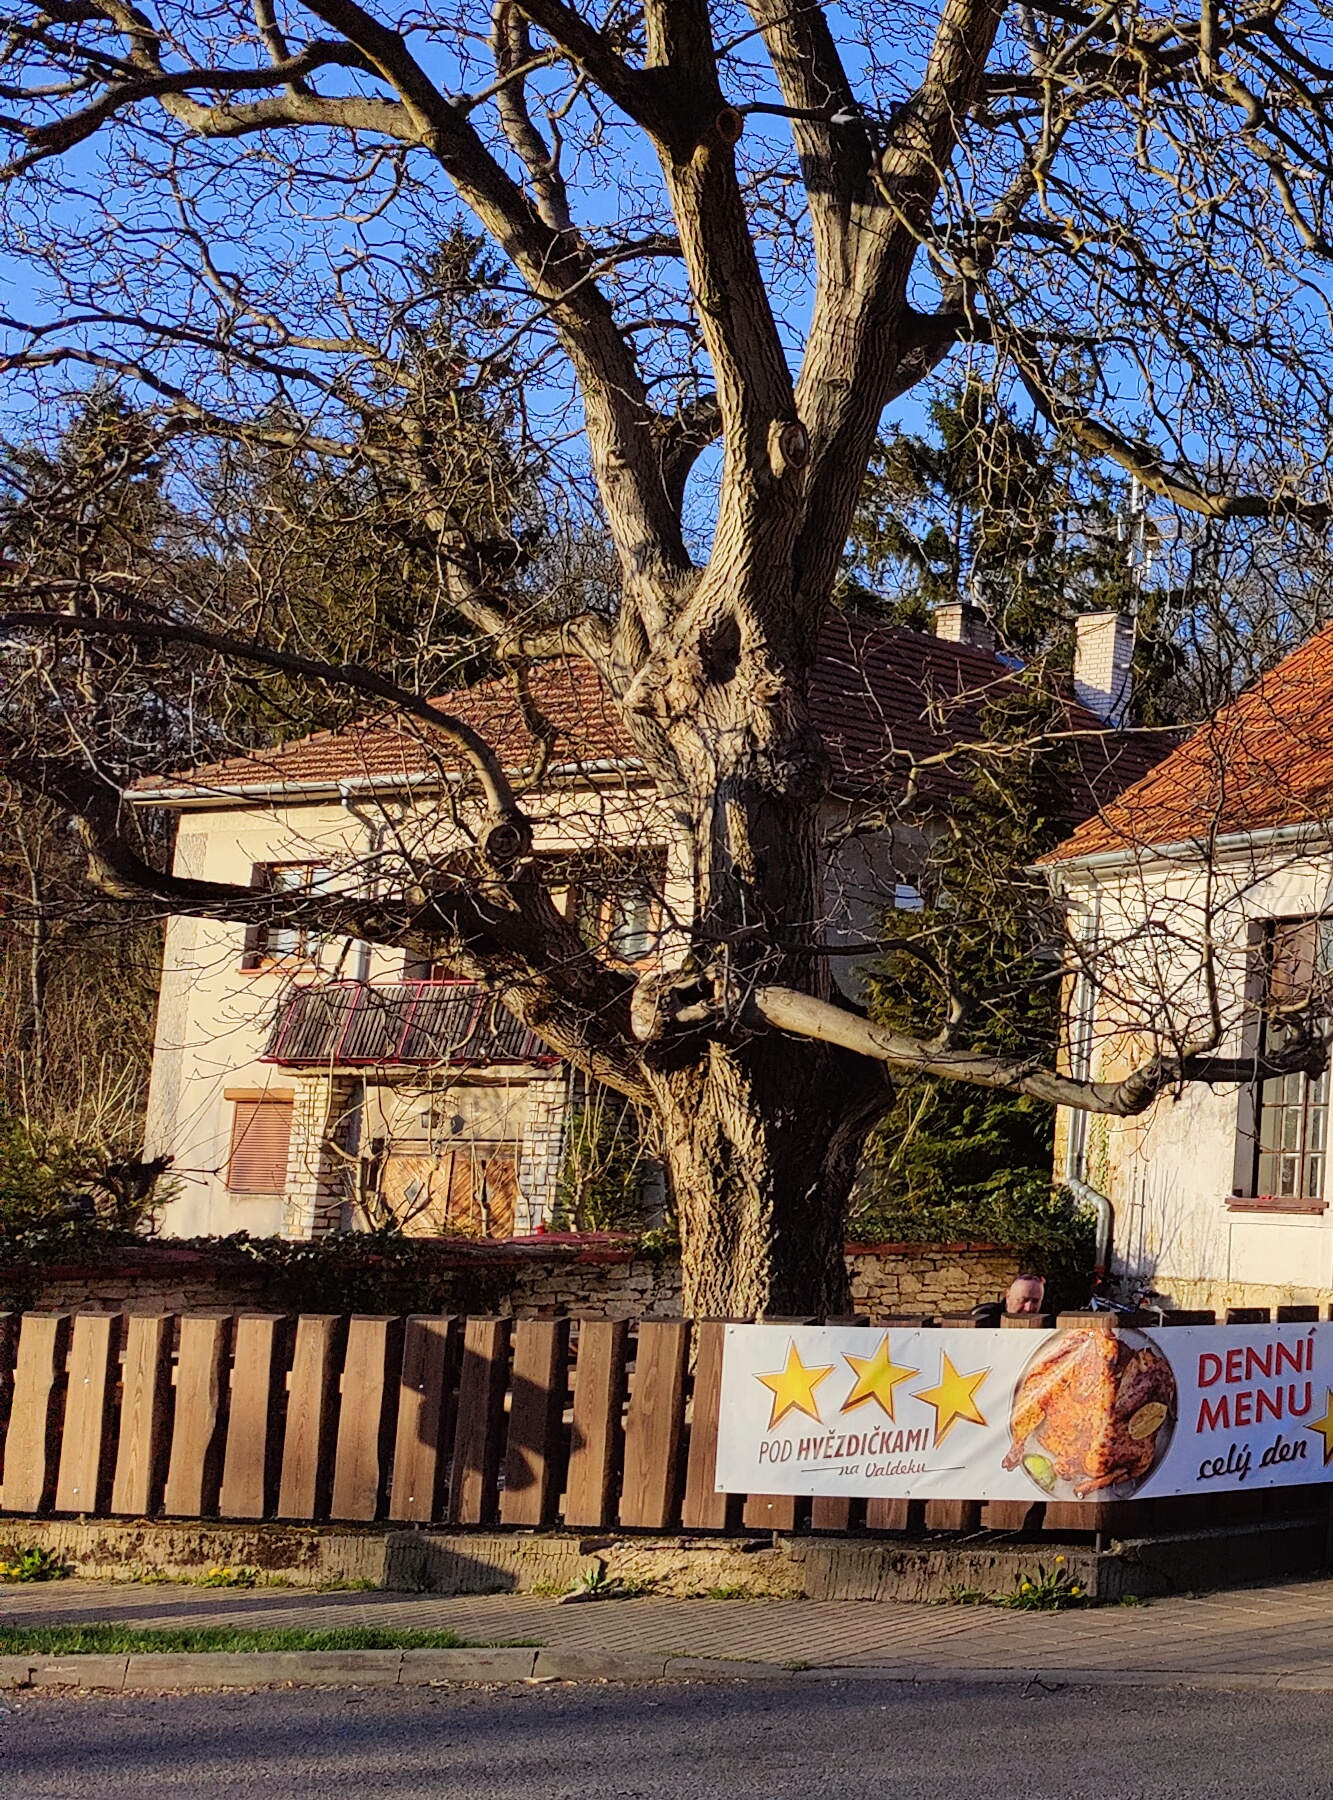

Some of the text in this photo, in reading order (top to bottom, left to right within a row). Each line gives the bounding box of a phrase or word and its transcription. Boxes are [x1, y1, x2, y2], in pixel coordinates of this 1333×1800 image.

[1198, 1327, 1317, 1388] DENNÍ
[1196, 1381, 1312, 1433] MENU
[759, 1425, 930, 1463] POD HVĚZDIČKAMI
[1196, 1434, 1307, 1481] celý den
[838, 1460, 927, 1478] na Valdeku
